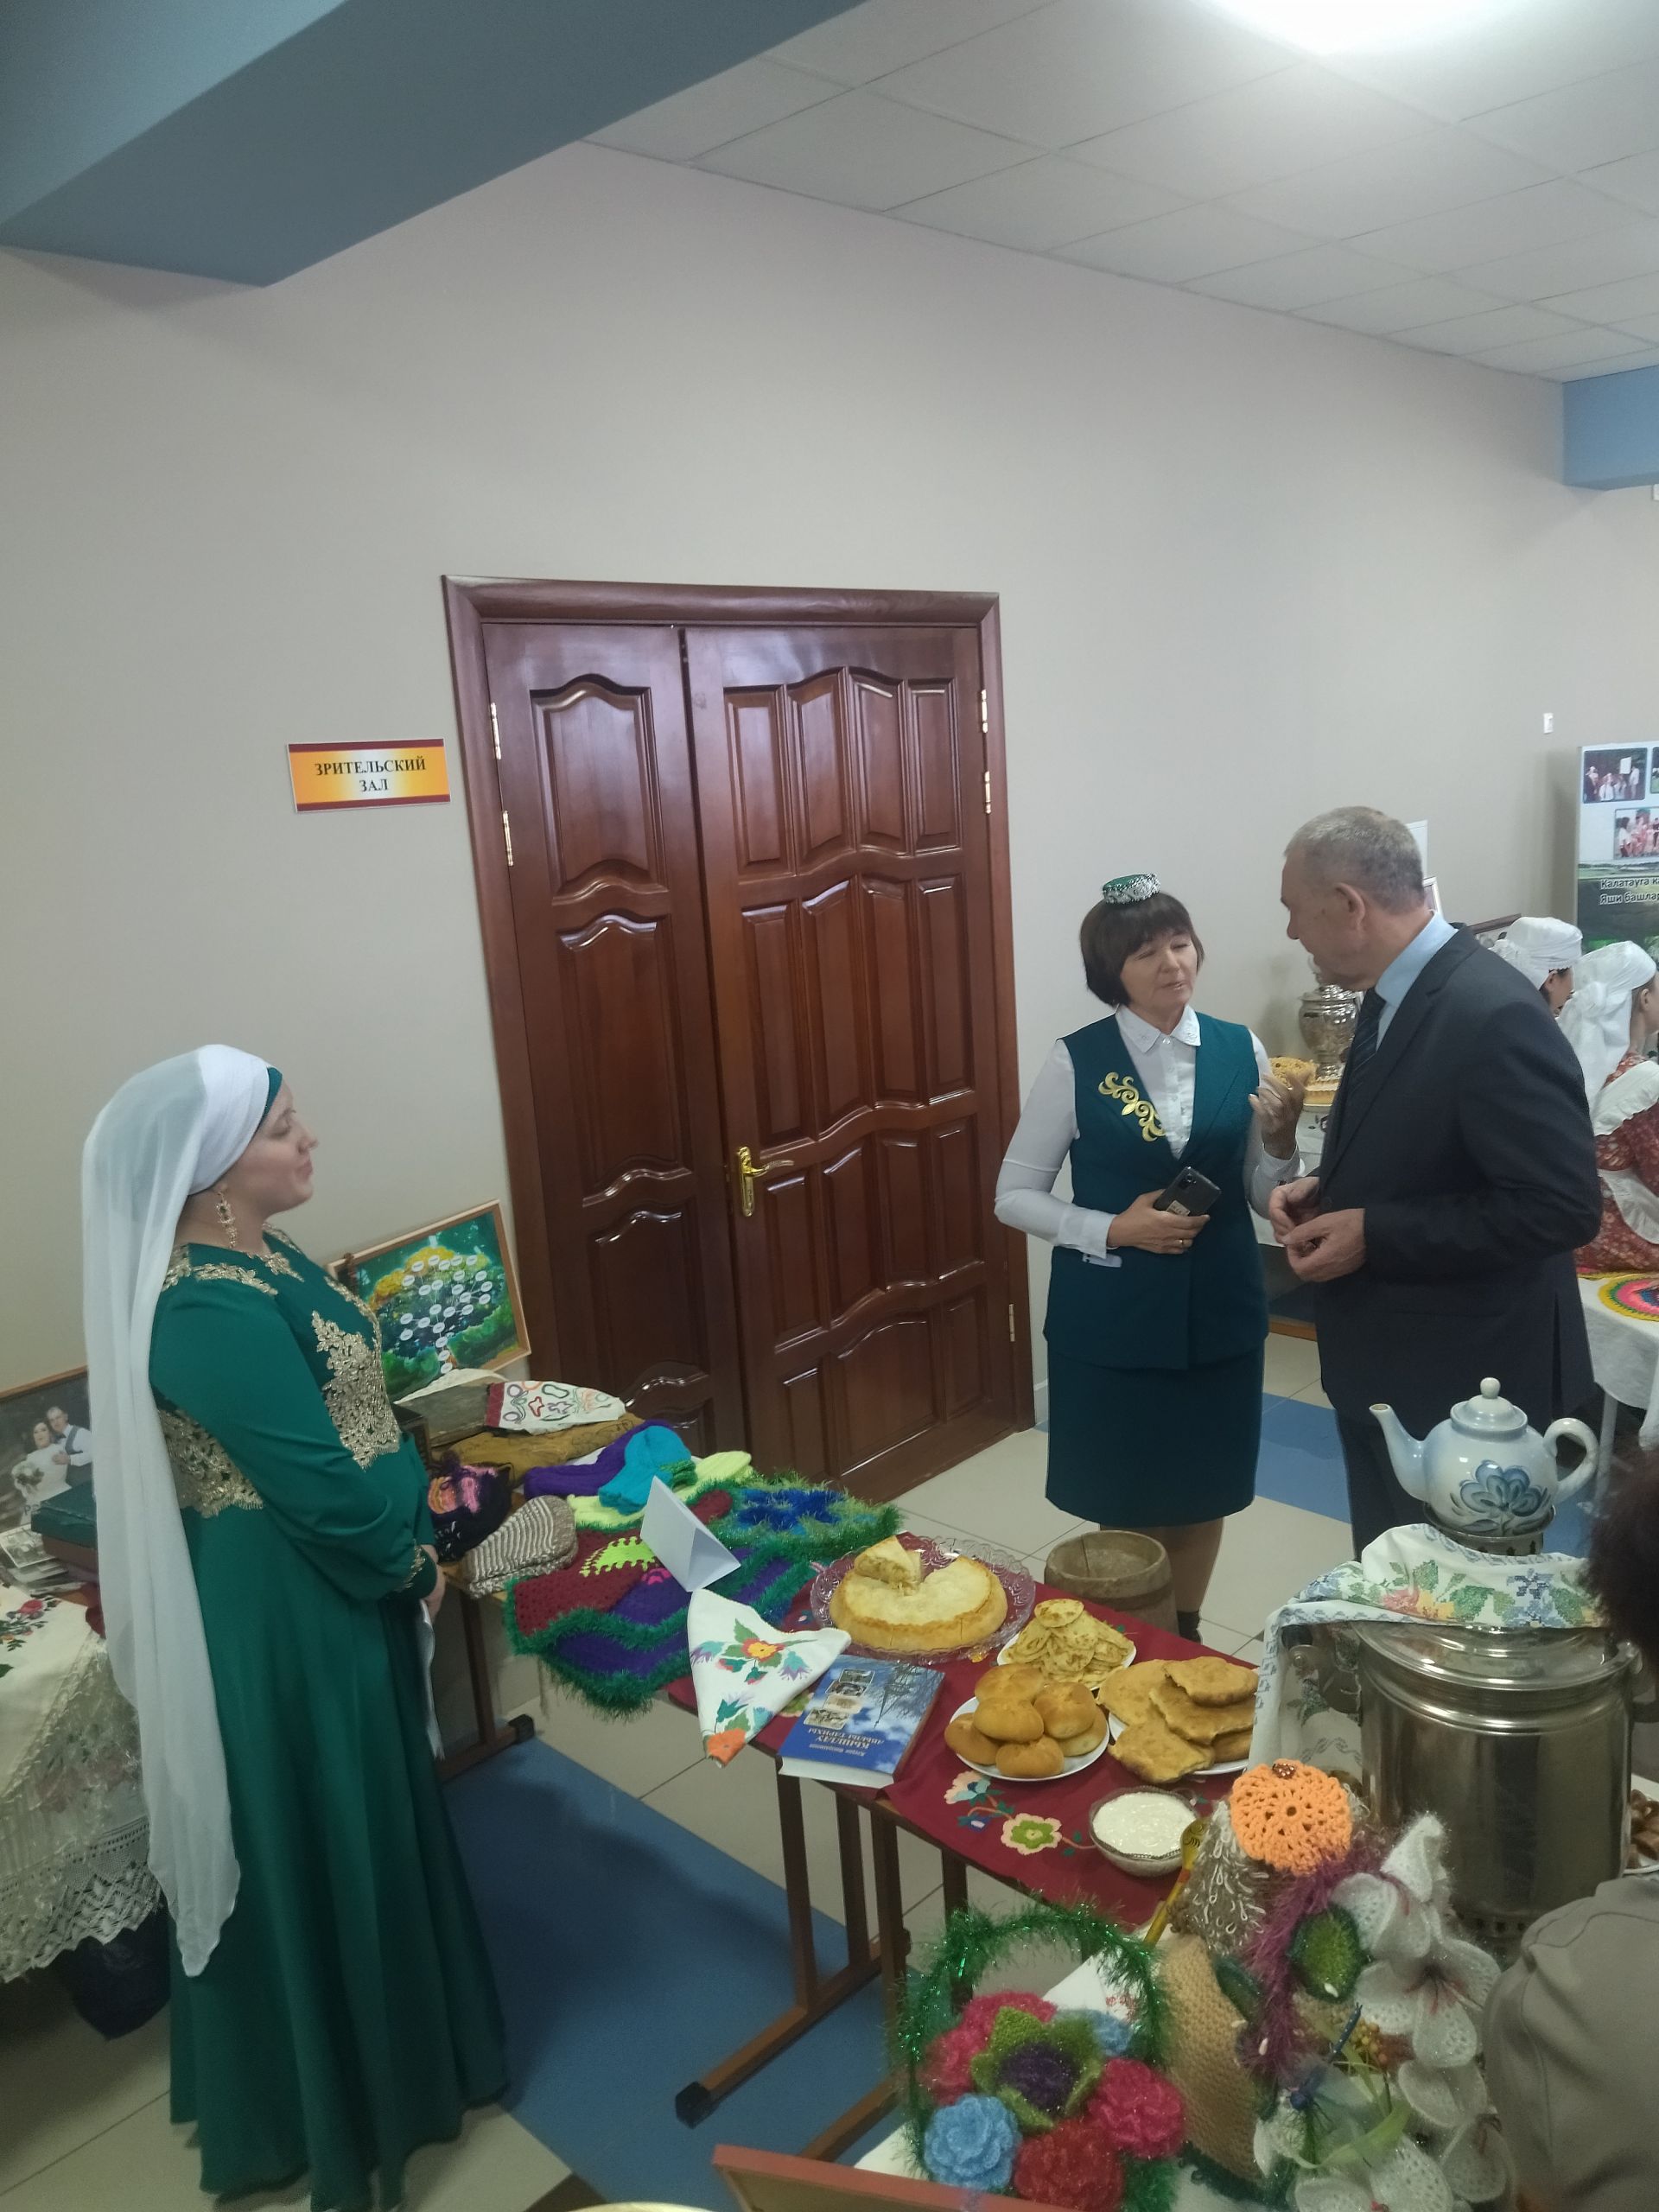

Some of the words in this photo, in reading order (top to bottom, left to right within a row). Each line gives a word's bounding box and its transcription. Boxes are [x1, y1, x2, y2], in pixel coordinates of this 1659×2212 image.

[315, 755, 426, 776] ЗРИТЕЛЬСКИЙ
[359, 779, 389, 792] ЗАЛ
[1601, 877, 1649, 889] Калатауга
[1599, 893, 1624, 906] Яши
